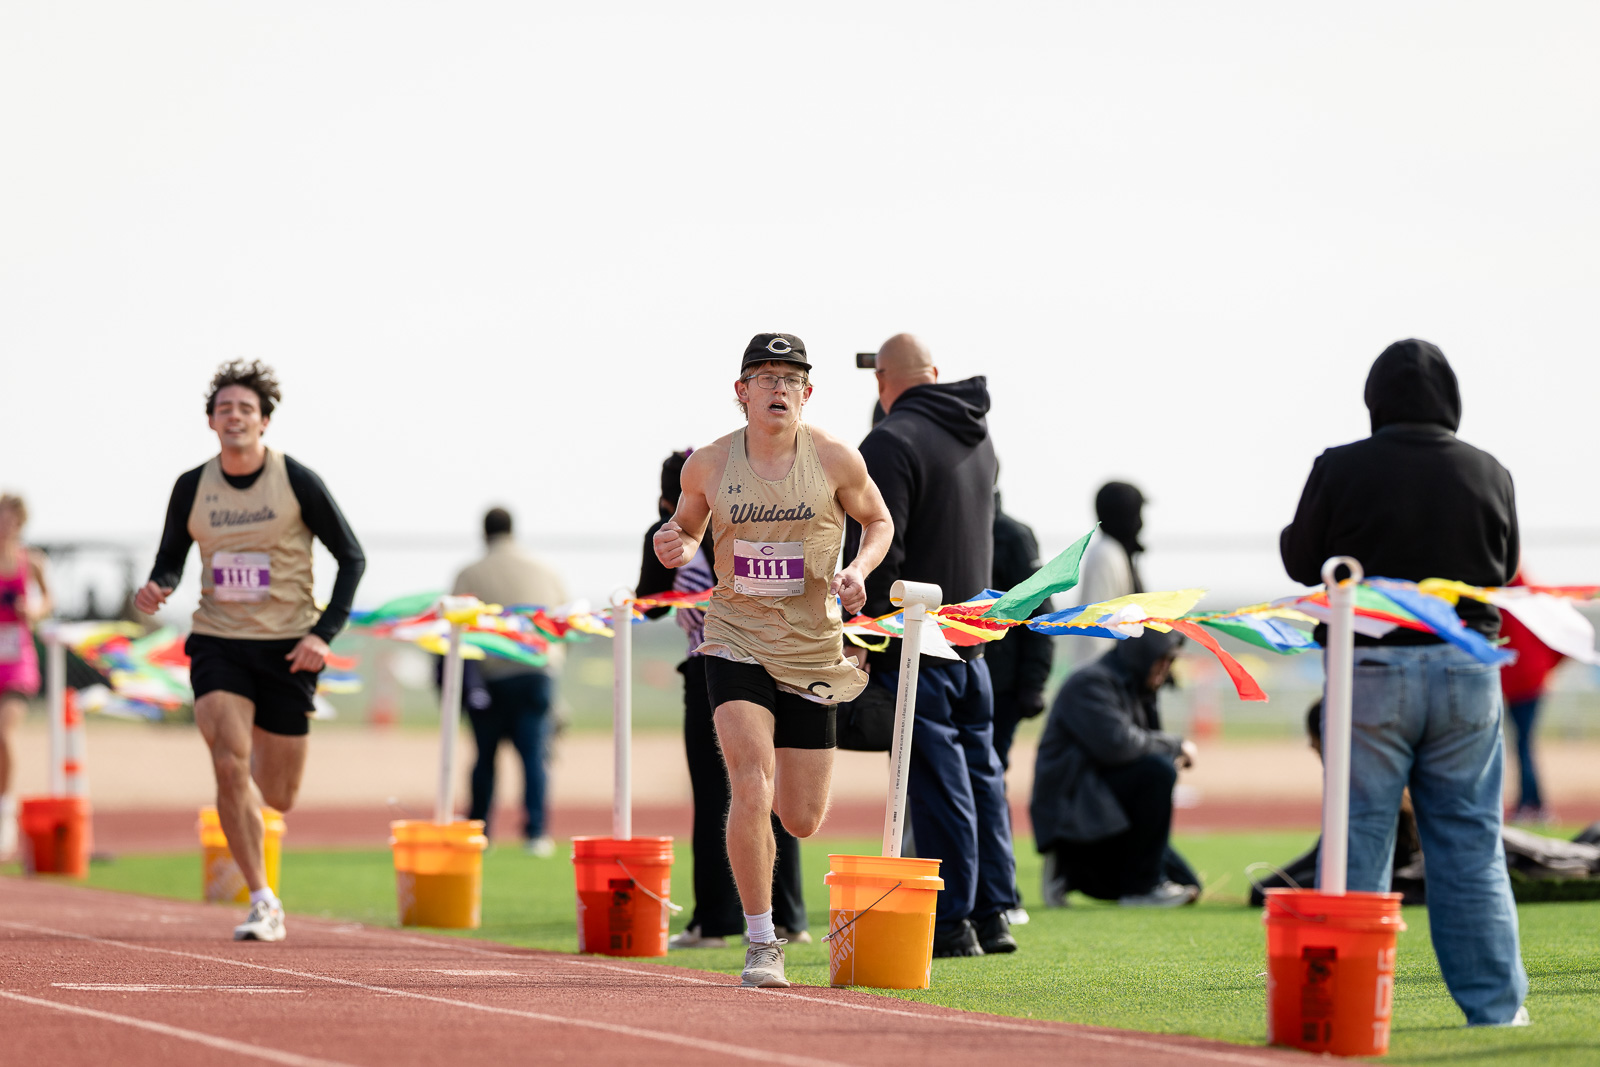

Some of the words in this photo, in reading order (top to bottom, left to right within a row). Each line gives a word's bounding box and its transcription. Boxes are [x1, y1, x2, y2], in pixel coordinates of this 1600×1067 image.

[730, 502, 816, 524] Wildcats
[222, 567, 260, 588] 1116
[747, 558, 790, 579] 1111
